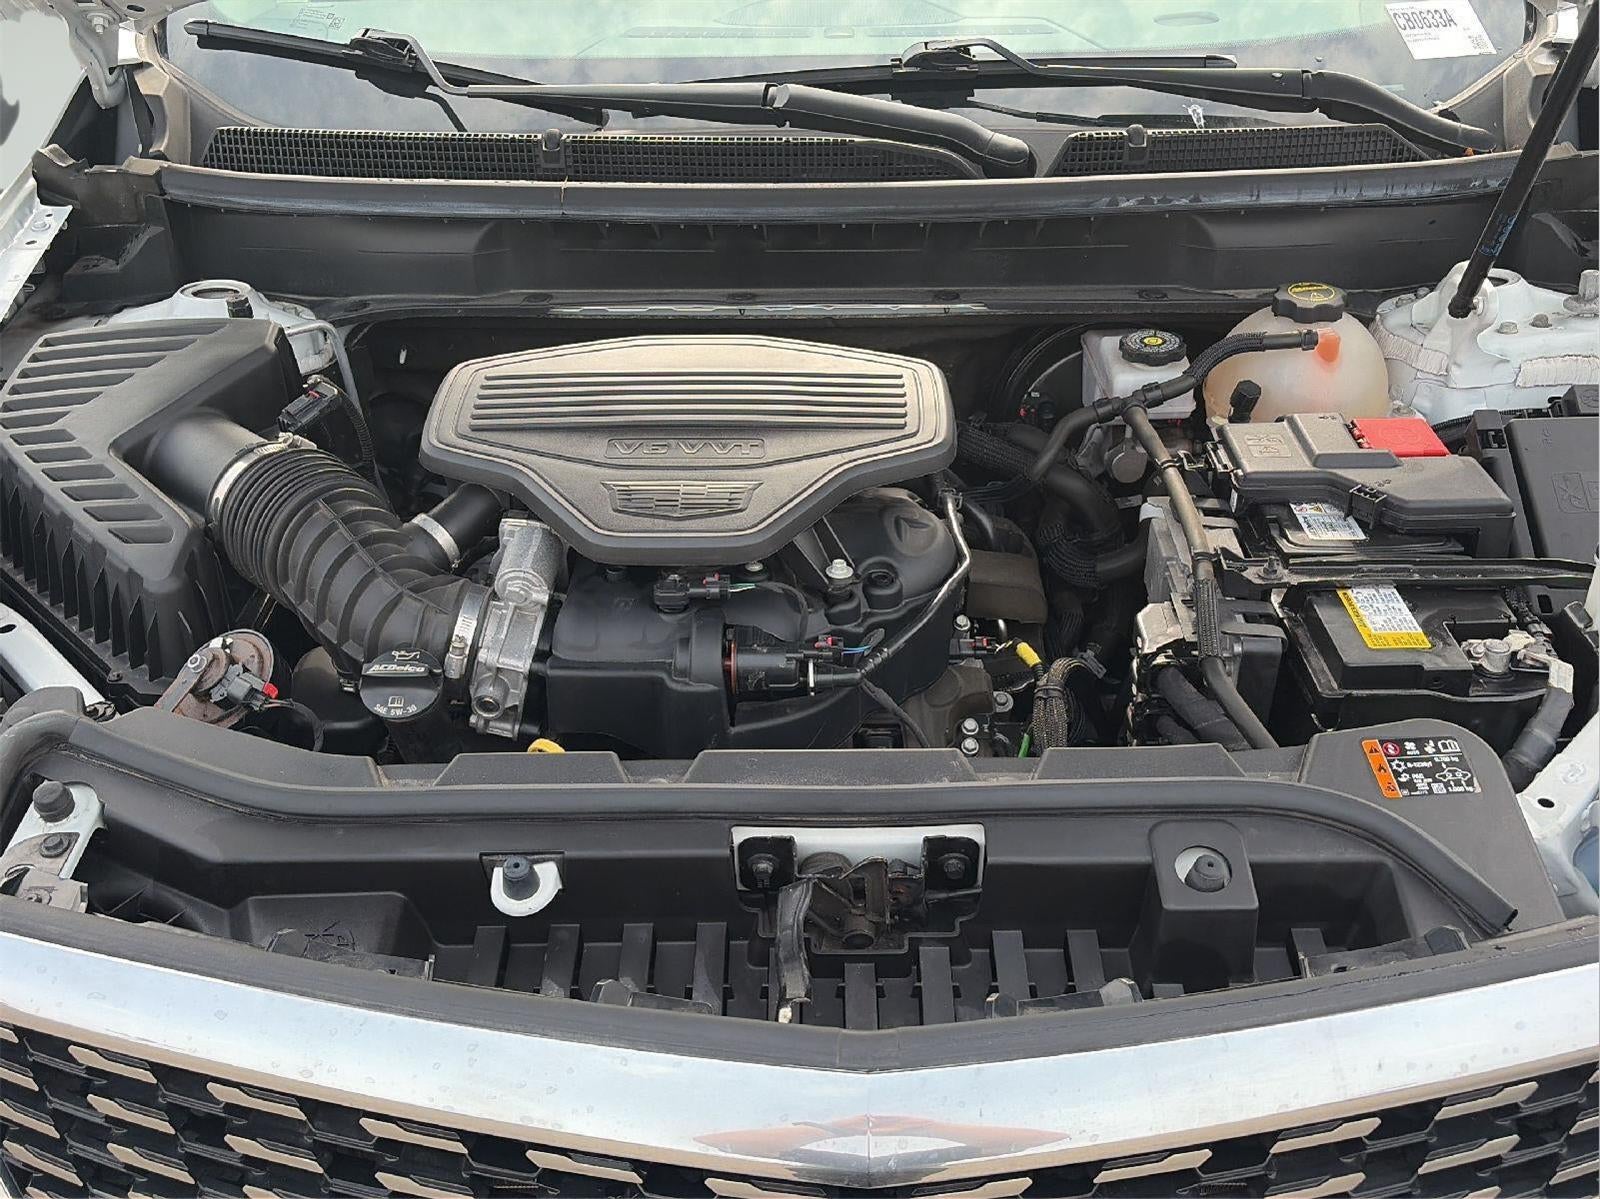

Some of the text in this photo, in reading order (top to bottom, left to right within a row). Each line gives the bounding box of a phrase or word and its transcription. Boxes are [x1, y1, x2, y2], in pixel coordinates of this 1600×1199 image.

[1393, 8, 1457, 30] CB0633A
[613, 441, 760, 455] V6 VVT
[369, 664, 425, 672] ACDelco
[374, 704, 417, 715] SAE 5W-30
